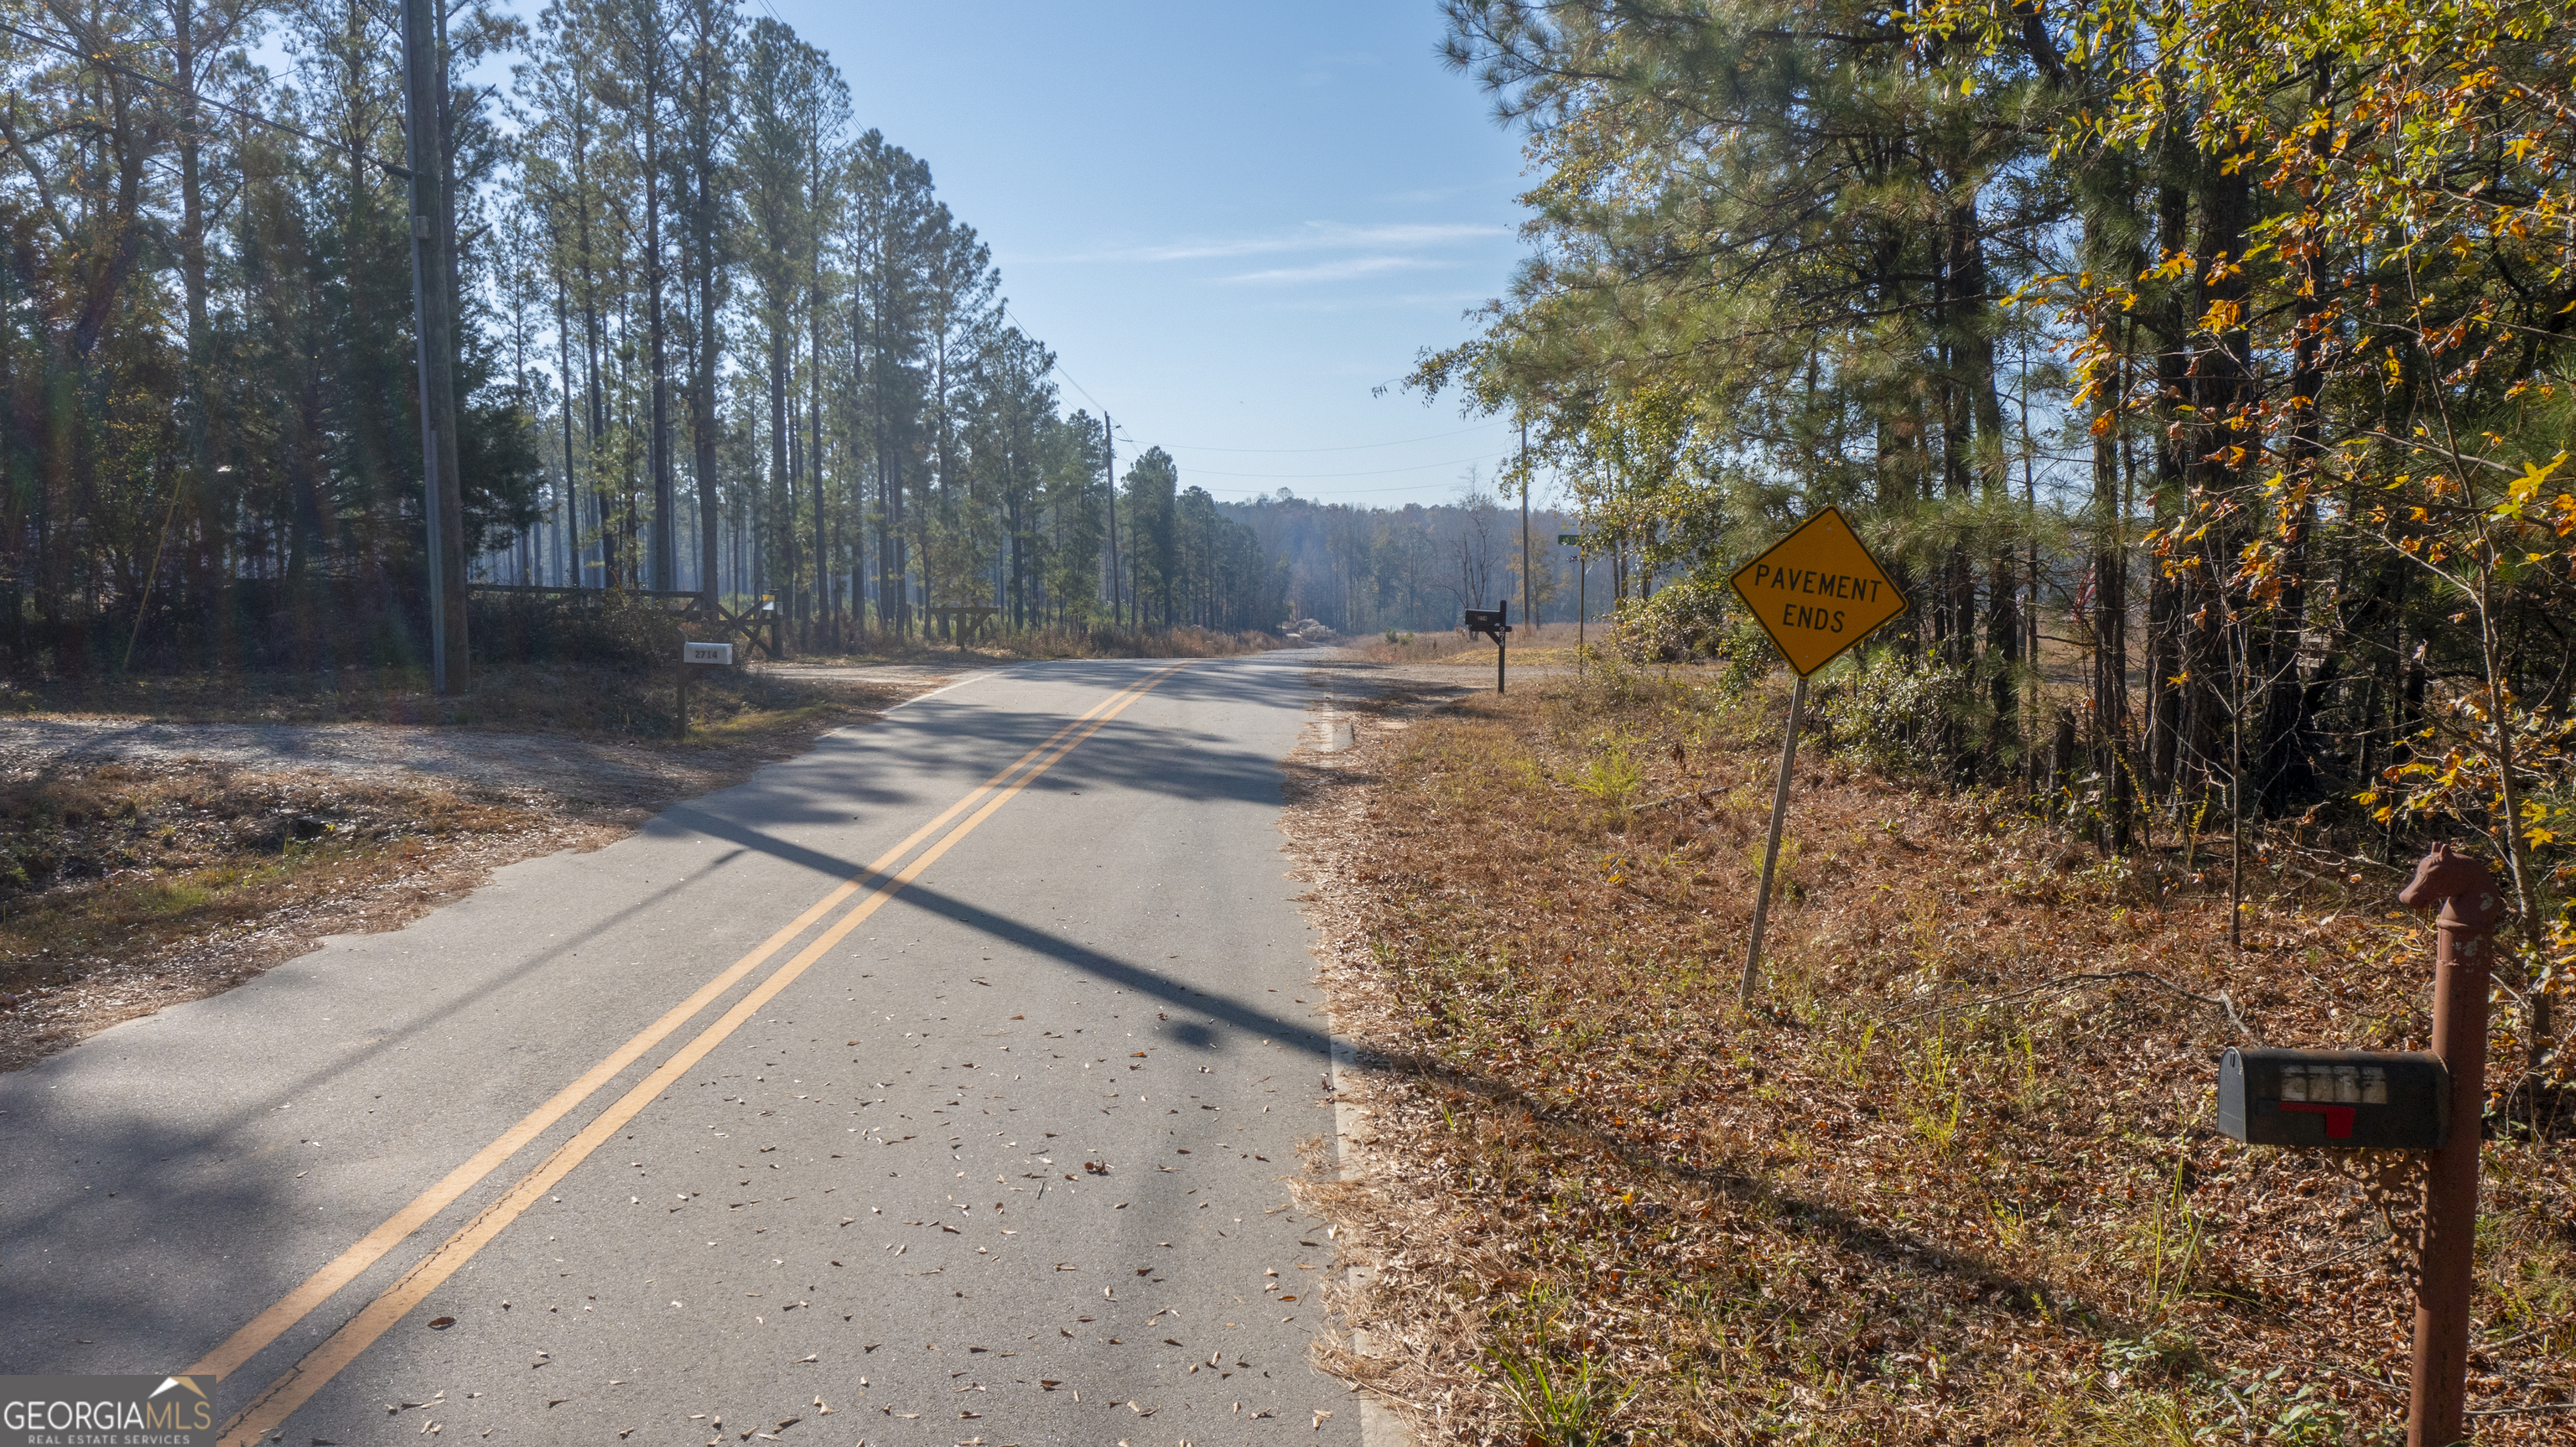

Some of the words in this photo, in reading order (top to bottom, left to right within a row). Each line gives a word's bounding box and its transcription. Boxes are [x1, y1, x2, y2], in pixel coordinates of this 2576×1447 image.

[1754, 563, 1882, 603] PAVEMENT
[1782, 604, 1846, 633] ENDS
[695, 651, 718, 659] 2714
